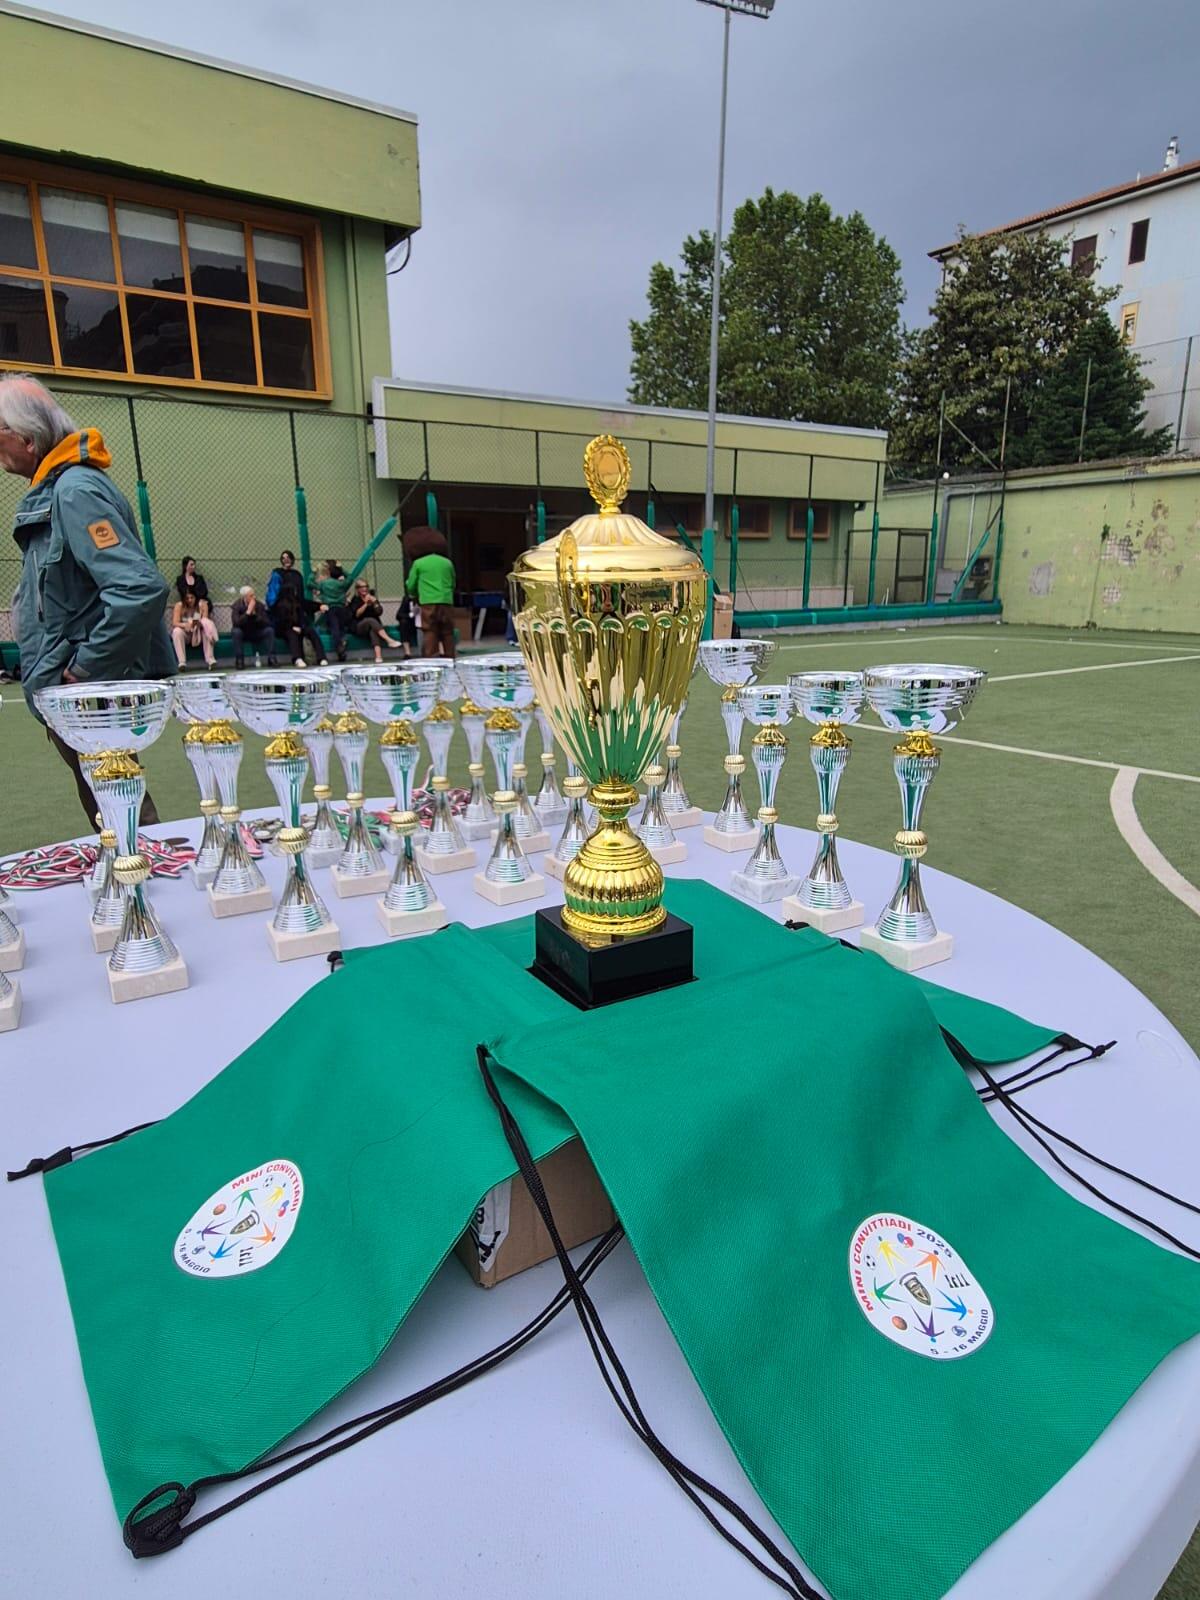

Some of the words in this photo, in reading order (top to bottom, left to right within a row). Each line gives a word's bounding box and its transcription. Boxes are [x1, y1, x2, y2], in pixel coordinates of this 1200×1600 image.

[231, 1170, 262, 1189] MINI
[853, 1218, 912, 1265] CONVITTIADI
[916, 1228, 953, 1259] 2025
[181, 1253, 211, 1273] MAGGIO
[854, 1269, 874, 1313] MINI
[952, 1343, 968, 1353] 16
[967, 1308, 989, 1344] MAGGIO
